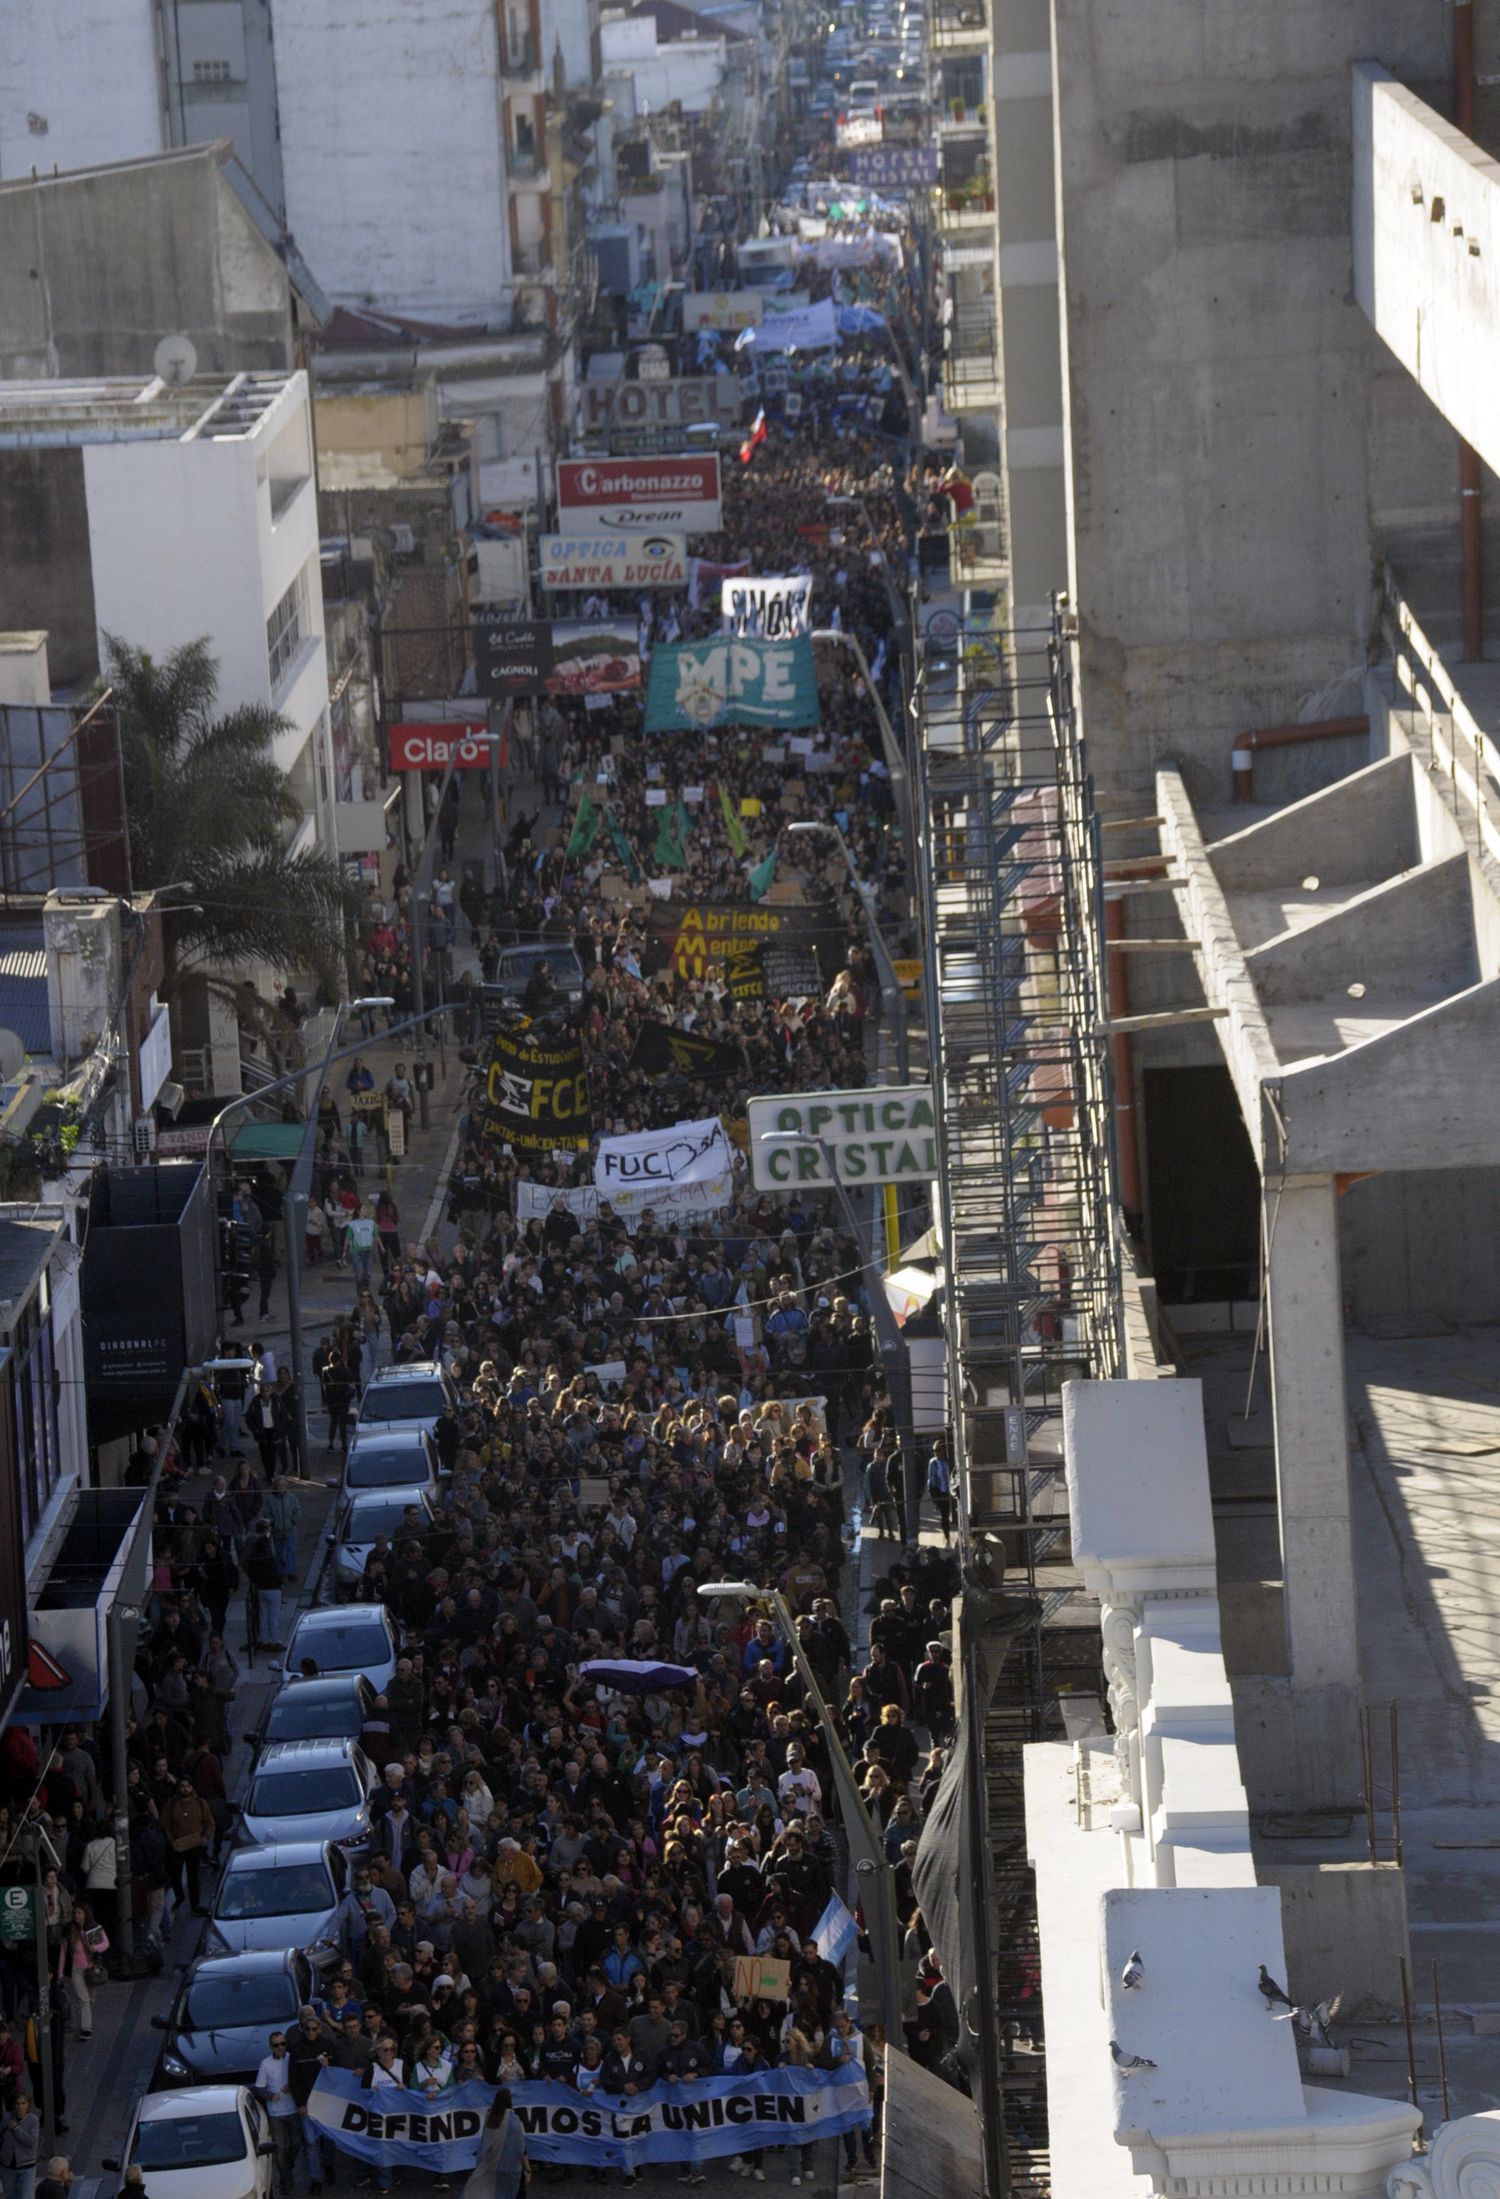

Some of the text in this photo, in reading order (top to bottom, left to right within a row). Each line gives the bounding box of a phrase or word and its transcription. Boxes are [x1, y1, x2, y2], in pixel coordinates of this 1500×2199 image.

[857, 151, 928, 169] HOTEL
[855, 168, 932, 185] CRISTAL
[588, 382, 733, 422] HOTEL
[580, 466, 704, 494] Carbonazzo
[613, 509, 683, 524] Drean
[551, 540, 627, 559] OPTICA
[547, 559, 682, 583] SANTA LUCÍA
[491, 664, 538, 679] CAGNOLI
[676, 645, 796, 702] MPE
[404, 737, 478, 762] Claro
[681, 907, 780, 932] Abriendo
[777, 1099, 935, 1135] OPTICA
[10, 1890, 23, 1907] E
[341, 2094, 806, 2143] DEFENDMOS LA UNICEN
